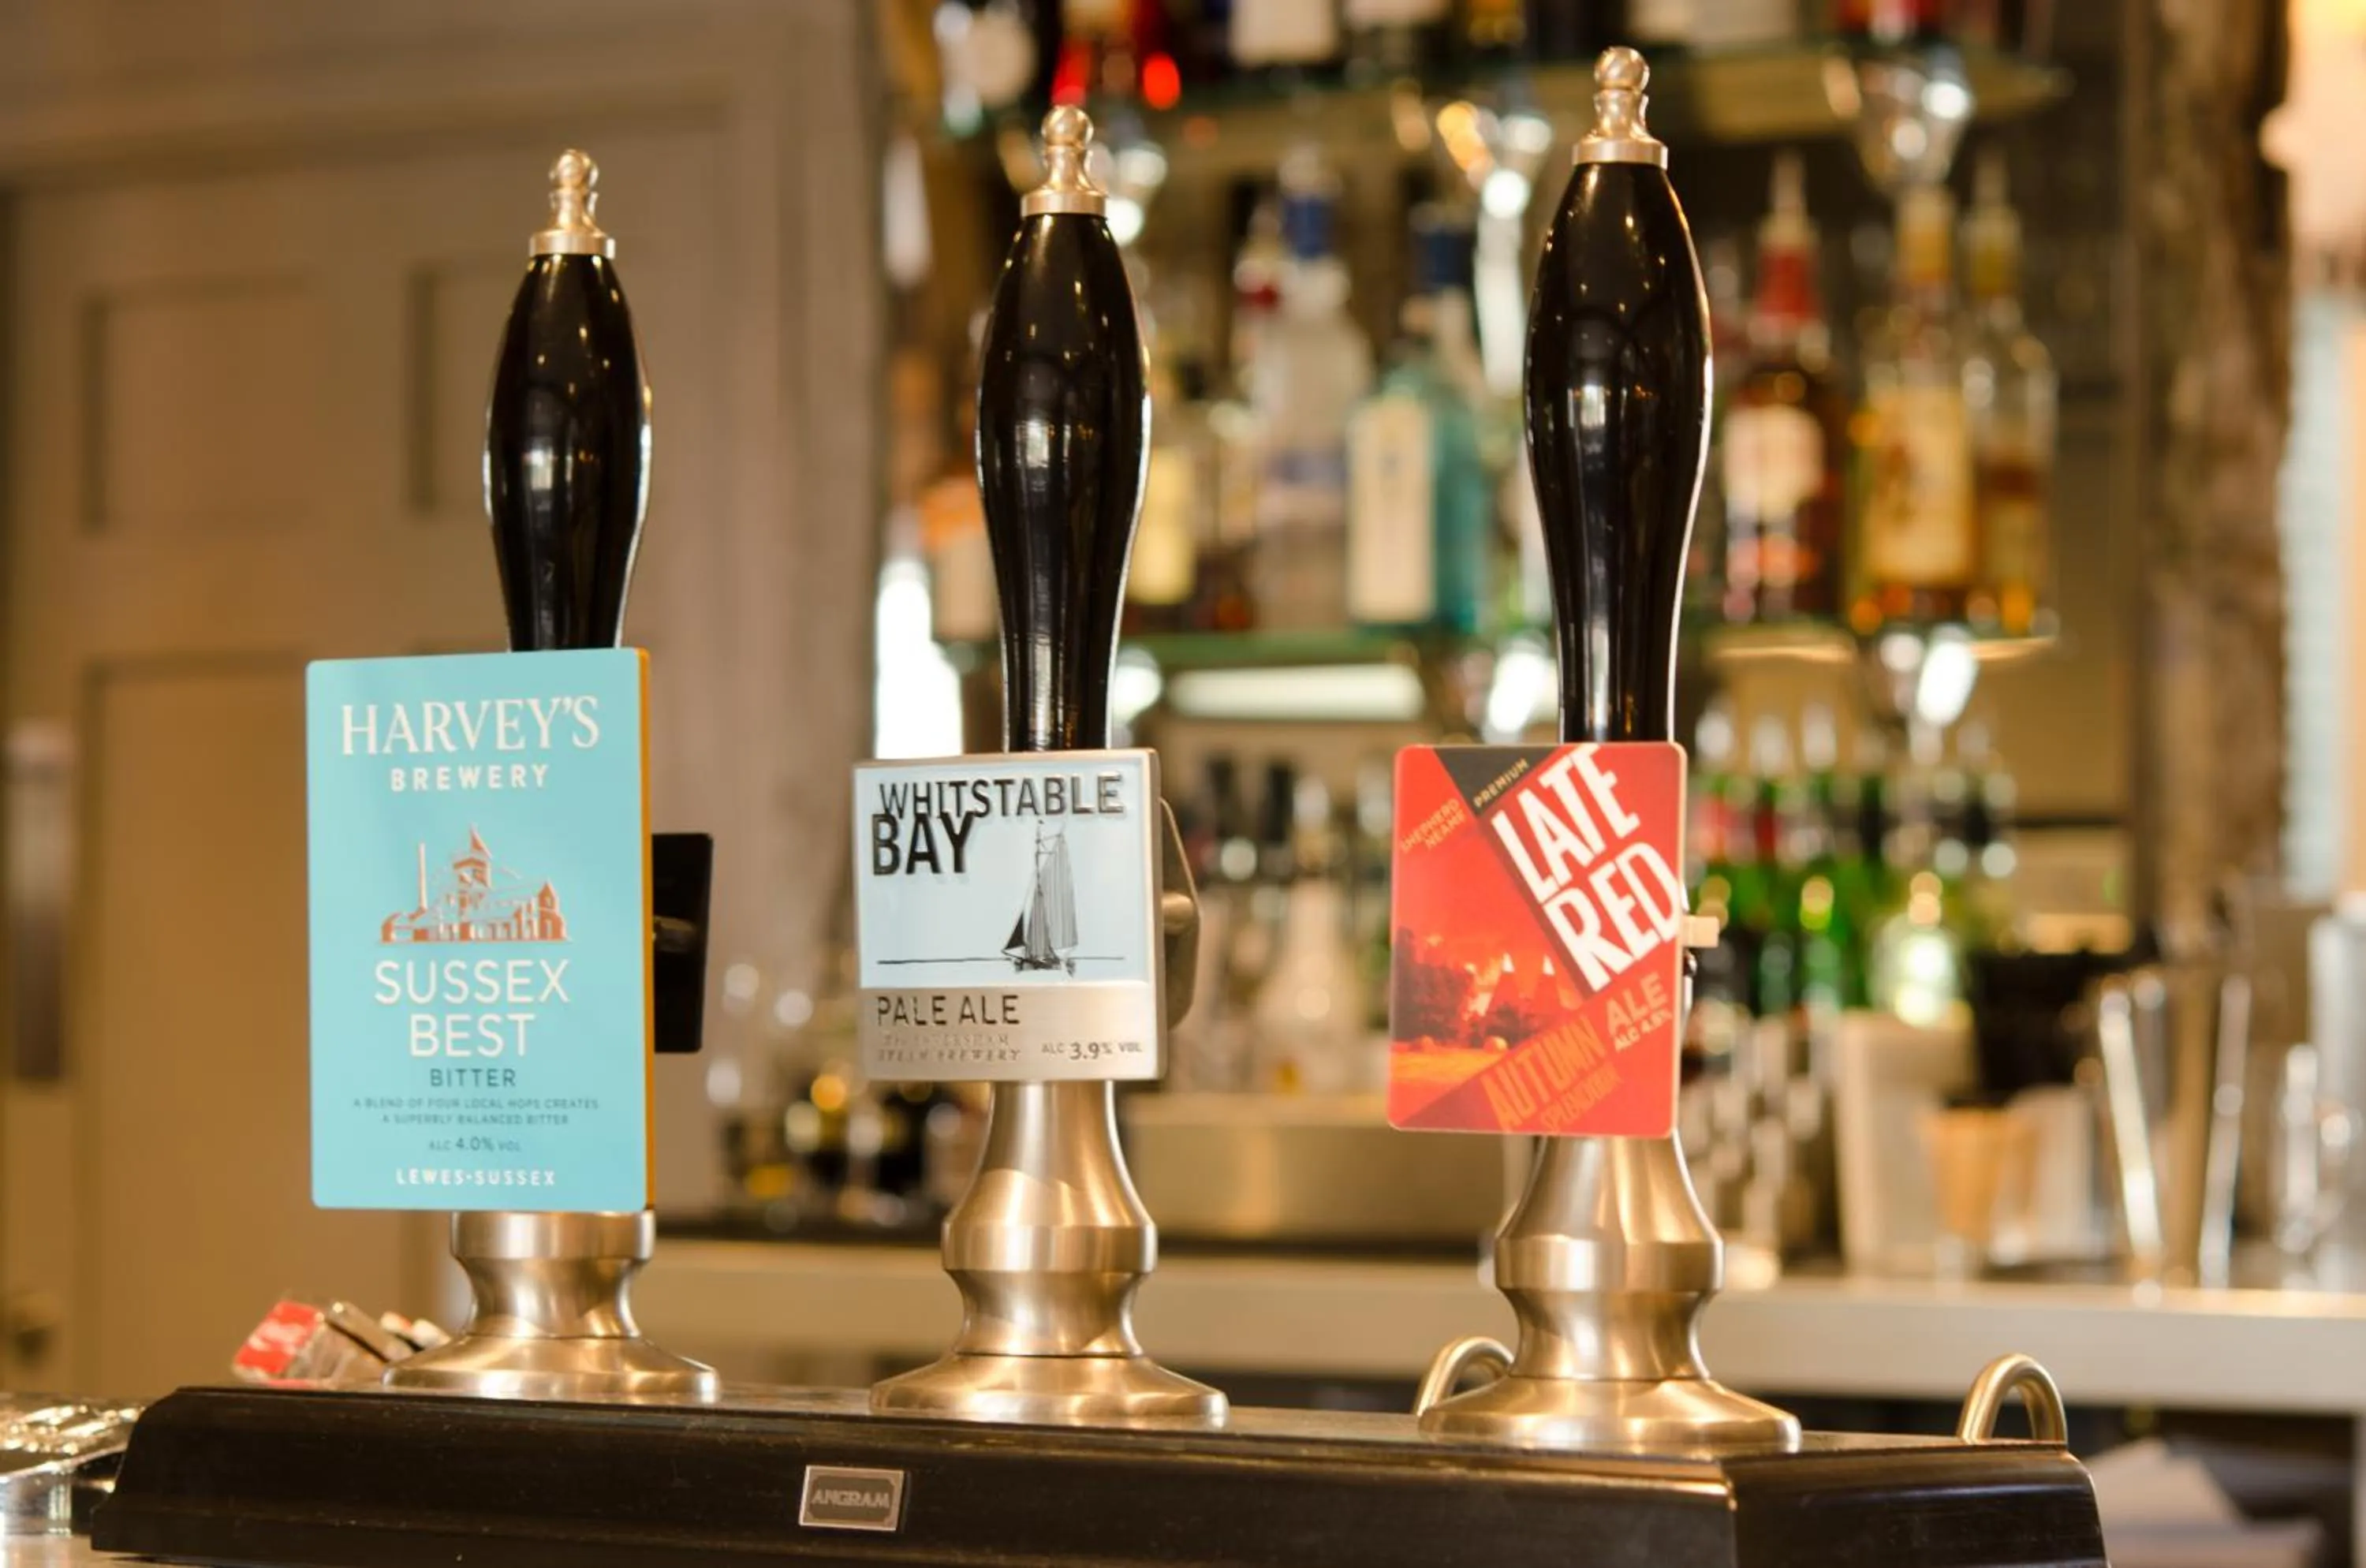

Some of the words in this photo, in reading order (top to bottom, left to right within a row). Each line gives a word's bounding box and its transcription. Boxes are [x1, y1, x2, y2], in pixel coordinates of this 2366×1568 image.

[341, 694, 600, 755] HARVEY'S
[390, 763, 549, 792] BREWERY
[879, 771, 1125, 820] WHITSTABLE
[1472, 756, 1529, 809] PREMIUM
[871, 809, 977, 877] BAY
[1491, 744, 1641, 905] LATE
[1543, 841, 1680, 994] RED
[373, 958, 571, 1004] SUSSEX
[1604, 971, 1669, 1038] ALE
[876, 995, 948, 1026] PALE
[958, 994, 1021, 1025] ALE
[409, 1013, 536, 1057] BEST
[430, 1068, 517, 1088] BITTER
[1478, 1014, 1607, 1132] AUTUMN
[455, 1136, 495, 1152] 4.0%
[812, 1488, 890, 1510] ANGRAM
